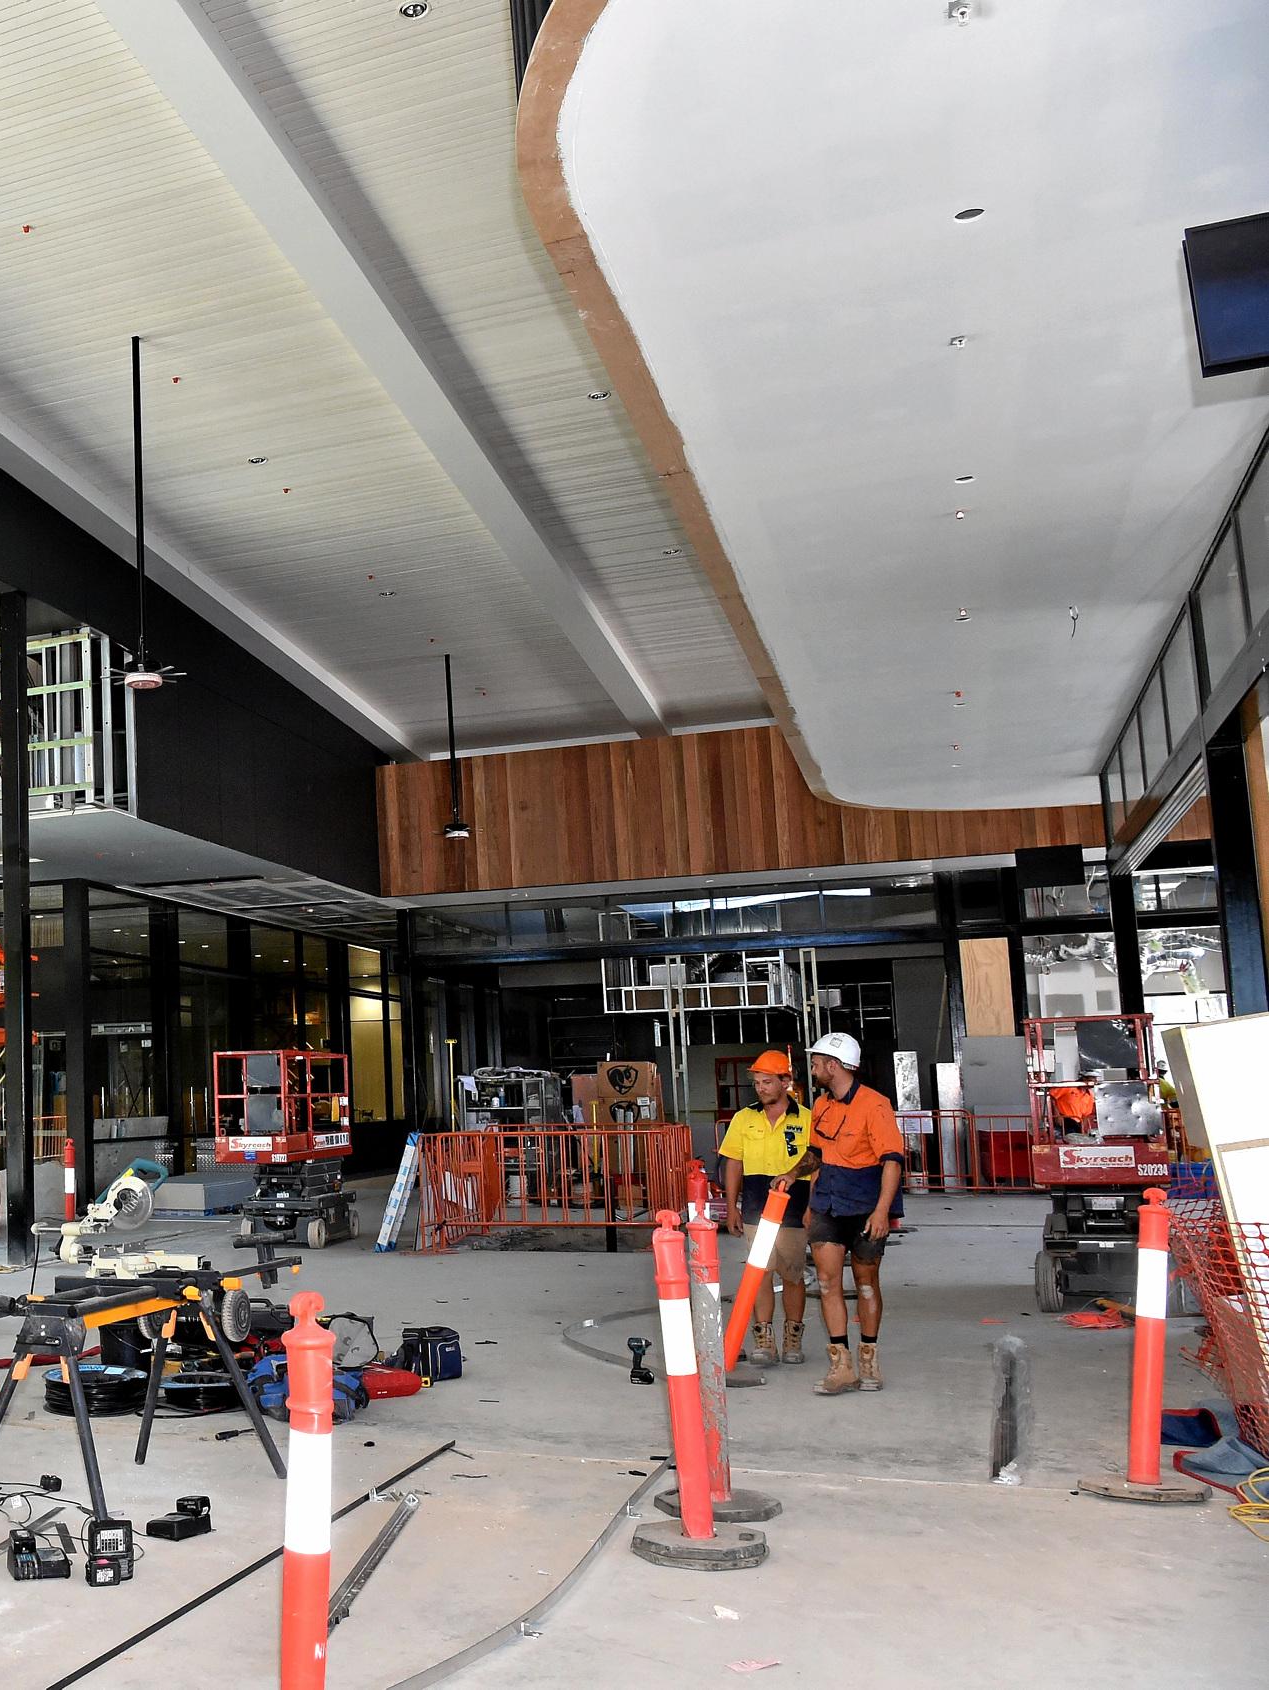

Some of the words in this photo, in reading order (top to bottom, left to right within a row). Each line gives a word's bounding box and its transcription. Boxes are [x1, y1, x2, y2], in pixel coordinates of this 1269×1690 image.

[231, 1138, 272, 1150] Skyreach
[1063, 1149, 1133, 1166] Skyreach
[1137, 1164, 1169, 1176] S20234
